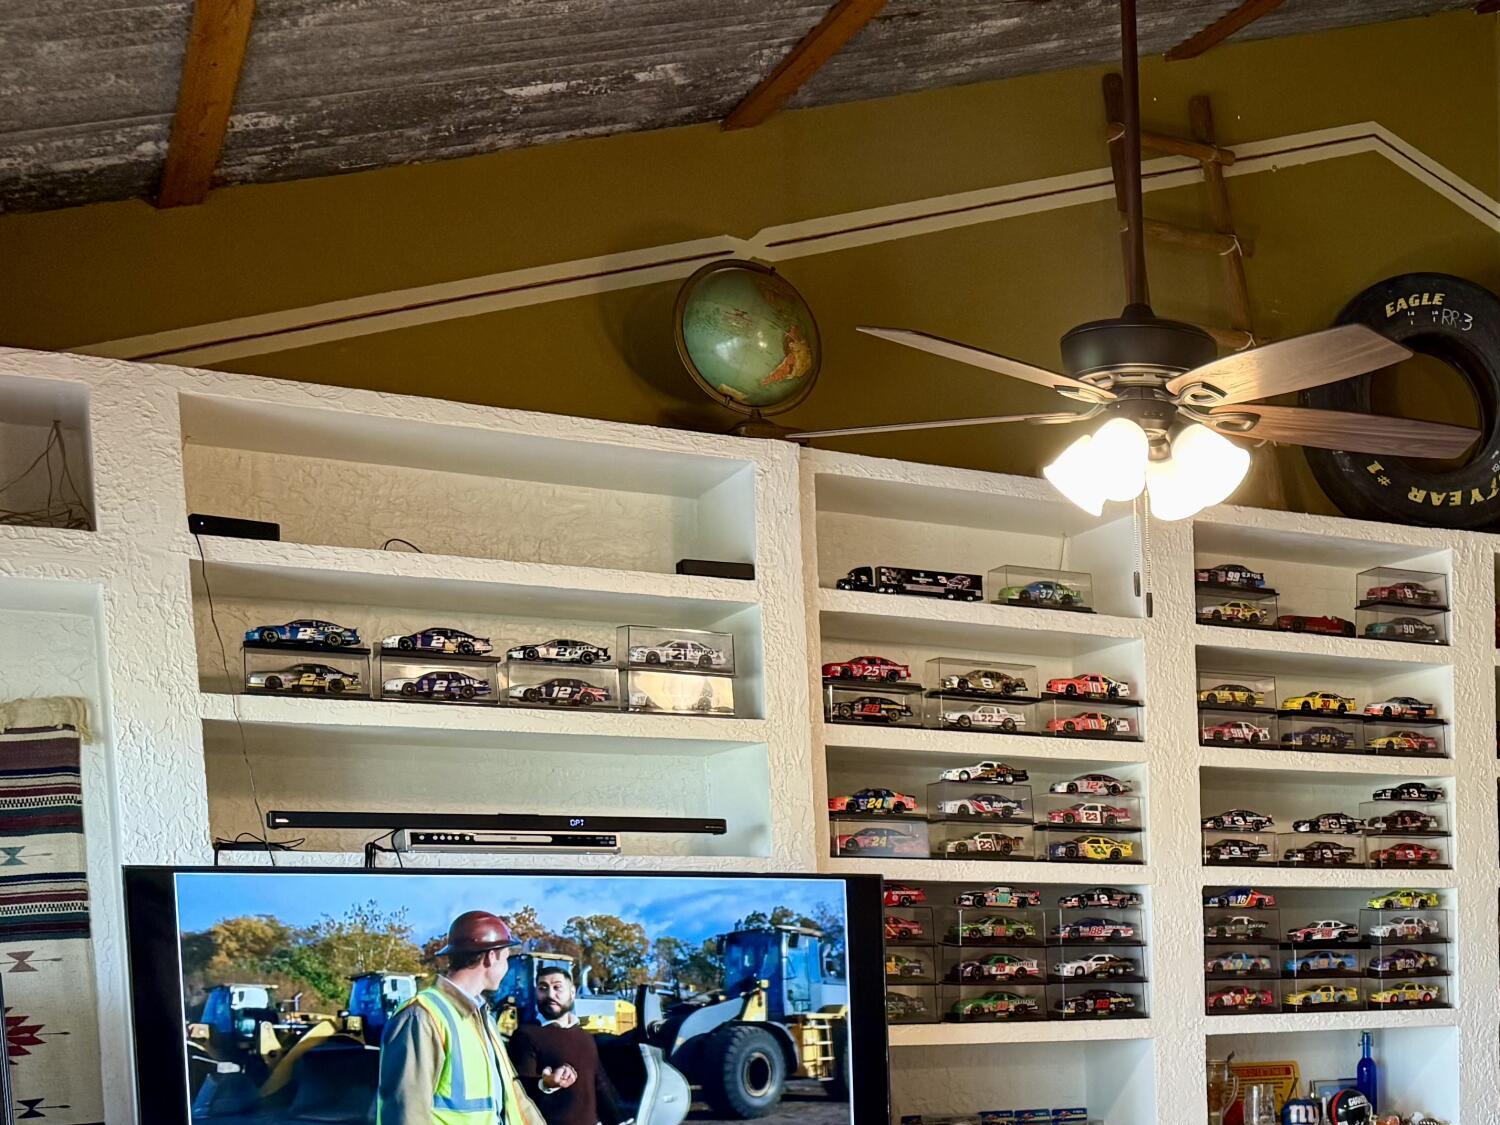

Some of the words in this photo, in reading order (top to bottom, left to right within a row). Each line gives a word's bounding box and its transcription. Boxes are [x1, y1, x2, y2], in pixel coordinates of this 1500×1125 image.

[1384, 292, 1446, 318] EAGLE
[552, 686, 572, 698] 12
[867, 797, 883, 809] 24
